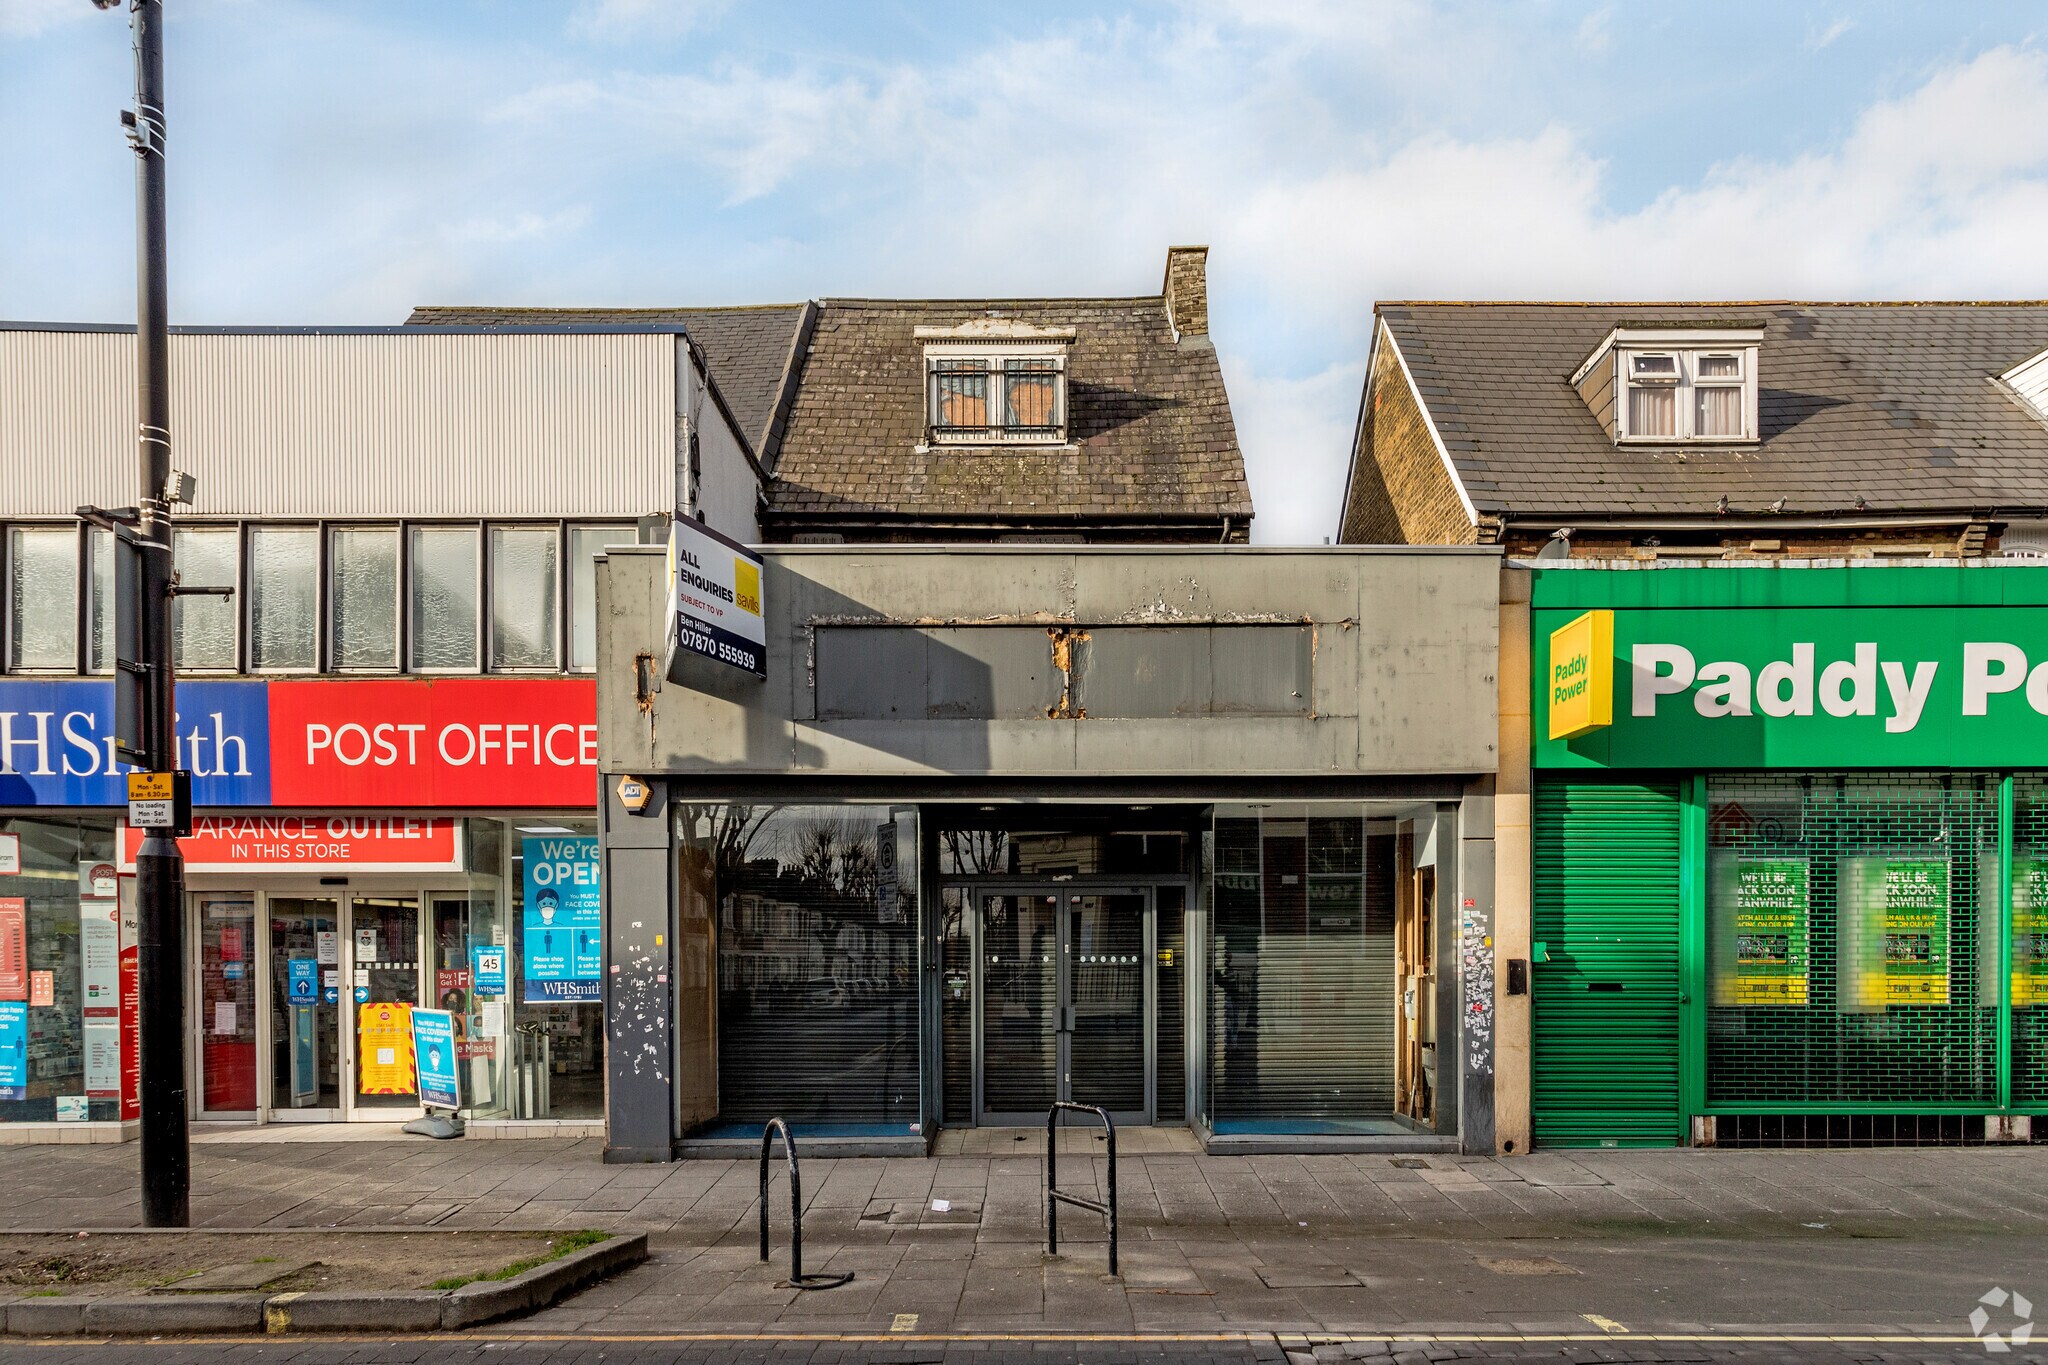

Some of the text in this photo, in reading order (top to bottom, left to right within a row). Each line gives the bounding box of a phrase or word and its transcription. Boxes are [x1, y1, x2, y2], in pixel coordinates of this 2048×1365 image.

[680, 549, 700, 570] ALL
[680, 567, 734, 603] ENQUIRIES
[680, 593, 724, 617] SUBJECT TO VP
[736, 593, 760, 614] savills
[681, 614, 712, 635] Ben Hiller
[681, 629, 755, 670] 07870 555939
[1555, 652, 1588, 684] Paddy
[1554, 675, 1588, 706] Power
[1632, 642, 1939, 733] Paddy
[306, 722, 597, 767] POST OFFICE
[624, 786, 641, 795] ADT
[191, 816, 438, 840] ARANCE OUTLET
[231, 843, 351, 858] IN THIS STORE
[540, 841, 600, 860] We're
[96, 869, 113, 877] POST
[1915, 872, 1928, 883] BE
[1738, 885, 1759, 895] ACK
[483, 958, 498, 969] 45
[440, 972, 453, 980] Buy
[415, 1026, 426, 1034] FACE
[427, 1028, 451, 1037] COVERING
[465, 1043, 493, 1053] Masks
[427, 1090, 451, 1102] WHSmith
